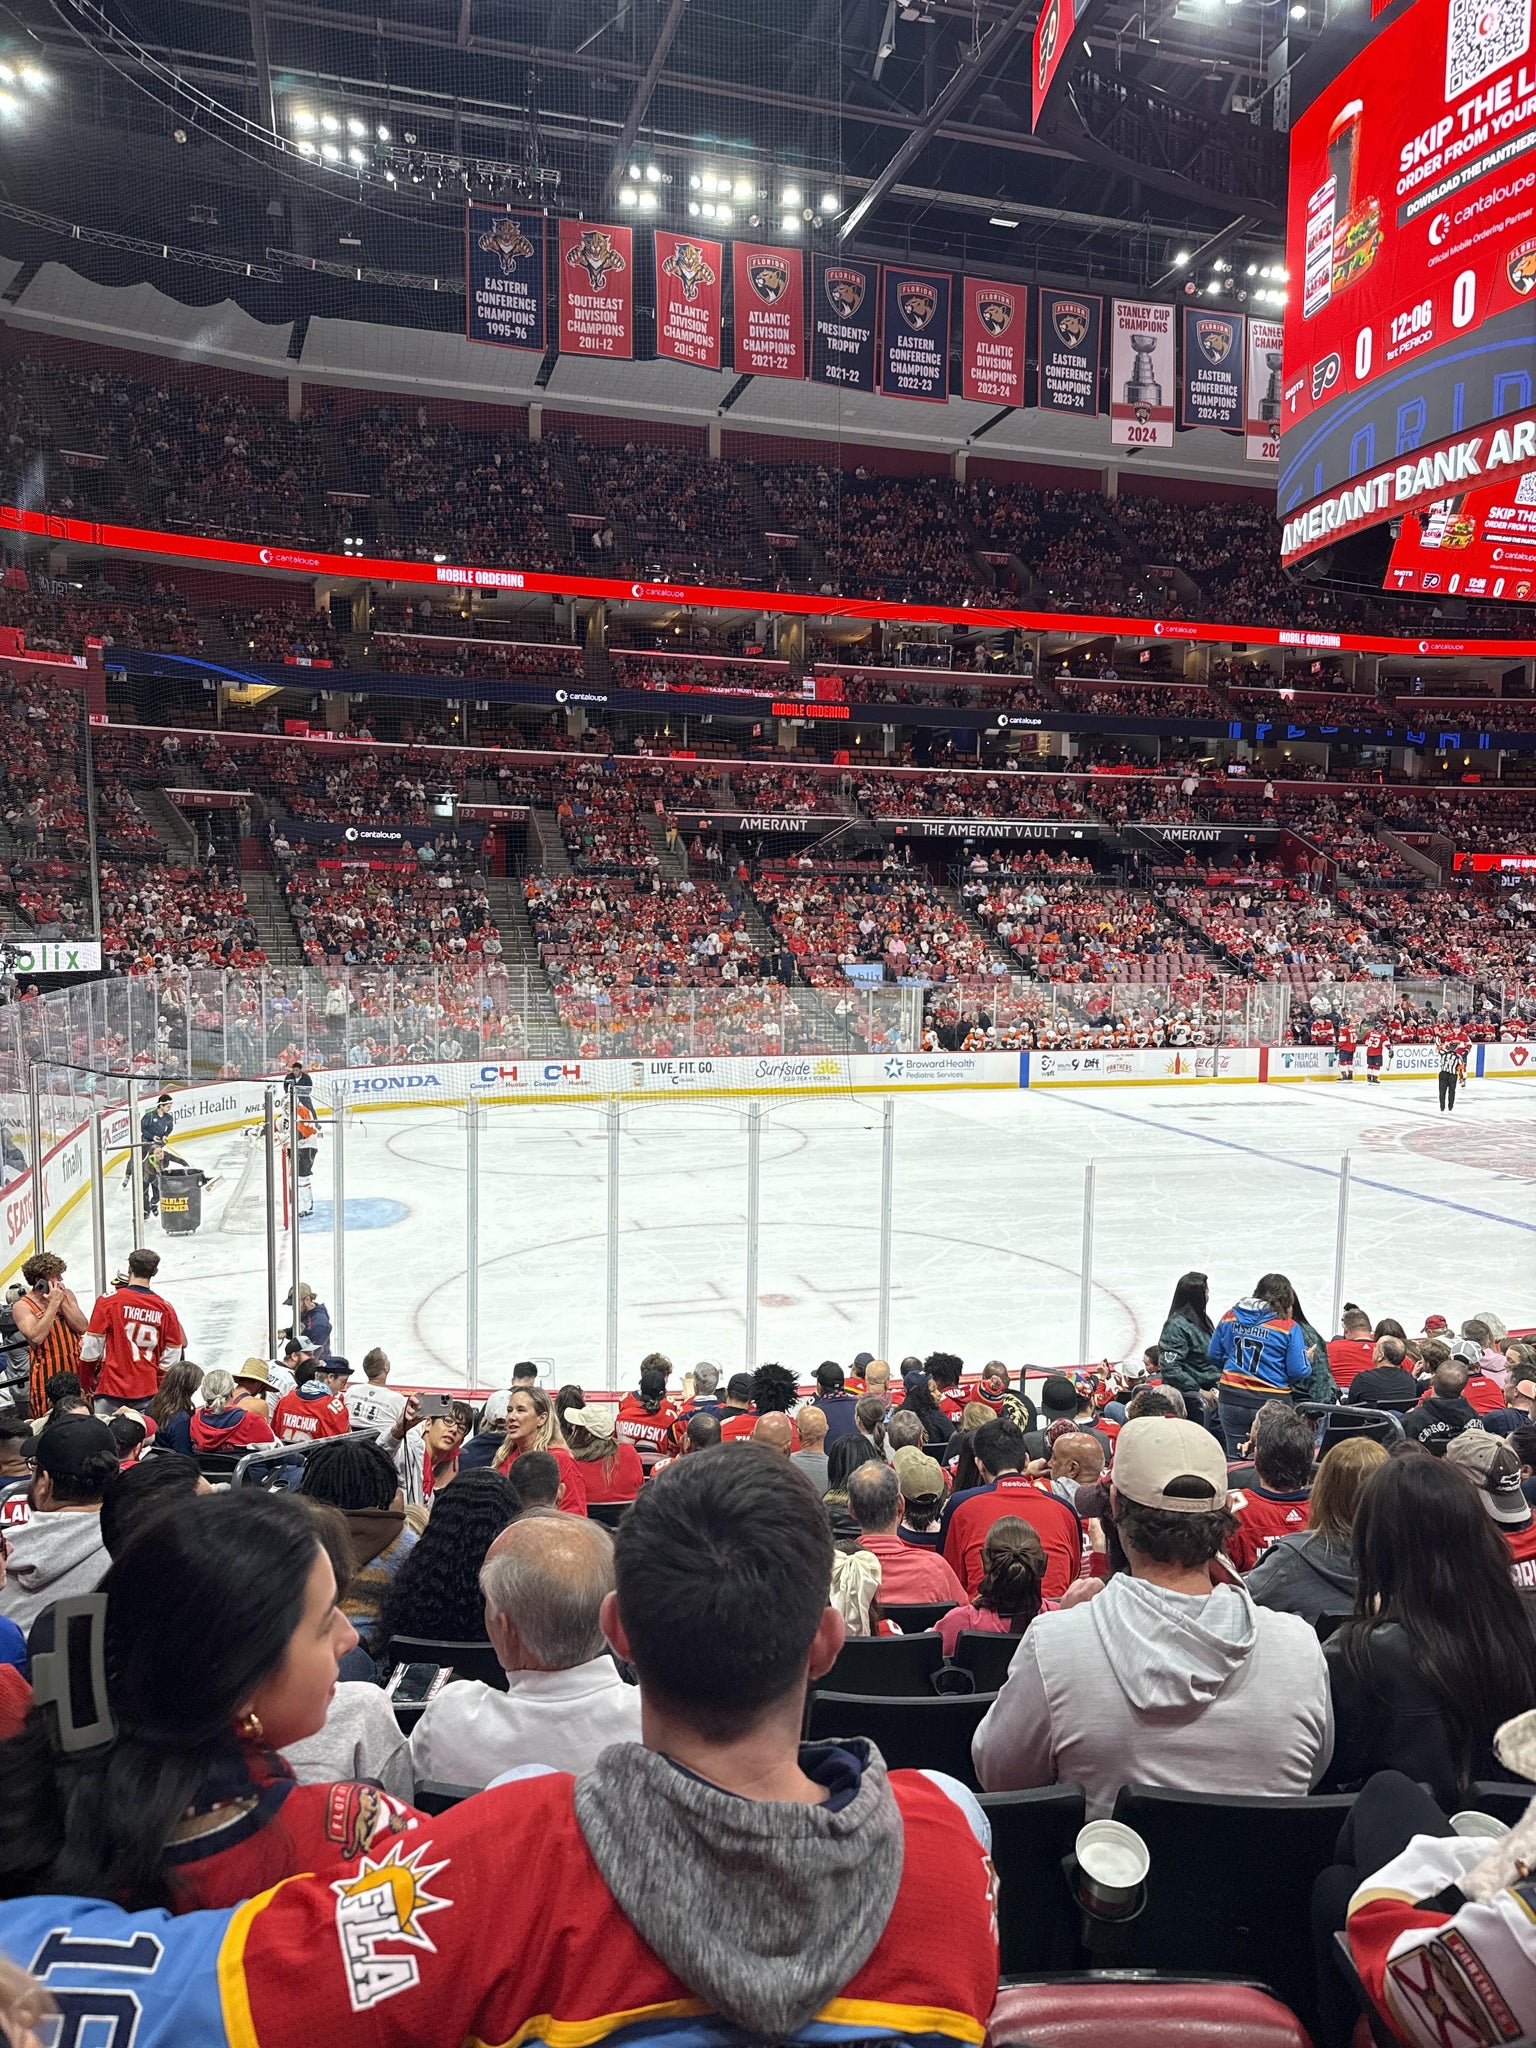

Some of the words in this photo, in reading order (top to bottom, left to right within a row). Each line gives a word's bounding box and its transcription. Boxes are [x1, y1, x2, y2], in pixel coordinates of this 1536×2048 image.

[1399, 115, 1453, 172] SKIP
[1457, 75, 1513, 132] THE
[1396, 153, 1442, 195] ORDER
[1444, 122, 1488, 165] FROM
[1491, 97, 1536, 135] YOUR
[1406, 175, 1460, 217] DOWNLOAD
[1460, 162, 1482, 184] THE
[1454, 172, 1536, 225] cantaloupe
[751, 258, 789, 270] FLORIDA
[829, 270, 863, 283] FLORIDA
[484, 278, 529, 295] EASTERN
[902, 286, 933, 298] FLORIDA
[476, 290, 538, 312] CONFERENCE
[568, 294, 624, 310] SOUTHEAST
[981, 294, 1010, 305] FLORIDA
[1452, 270, 1477, 328] 0
[478, 305, 536, 326] CHAMPIONS
[574, 308, 618, 323] DIVISION
[669, 302, 710, 321] ATLANTIC
[748, 311, 790, 326] ATLANTIC
[1057, 305, 1088, 317] FLORIDA
[1117, 305, 1148, 319] STANLEY
[1149, 308, 1171, 322] CUP
[567, 320, 624, 338] CHAMPIONS
[670, 315, 708, 334] DIVISION
[1119, 318, 1168, 334] CHAMPIONS
[1201, 322, 1230, 333] FLORIDA
[1390, 299, 1432, 344] 12:06
[487, 322, 528, 340] 1995-96
[664, 326, 714, 349] CHAMPIONS
[749, 326, 790, 341] DIVISION
[579, 337, 614, 351] 2011-12
[674, 343, 707, 360] 2015-16
[743, 339, 796, 356] CHAMPIONS
[827, 338, 860, 355] TROPHY
[898, 336, 935, 351] EASTERN
[976, 341, 1014, 358] ATLANTIC
[1255, 337, 1283, 351] CHAMP
[1386, 344, 1399, 362] 1st
[1399, 330, 1432, 356] PERIOD
[890, 348, 942, 366] CONFERENCE
[1052, 353, 1087, 369] EASTERN
[1355, 326, 1373, 380] 0
[752, 354, 789, 370] 2021-22
[977, 355, 1012, 371] DIVISION
[826, 365, 860, 383] 2021-22
[891, 362, 940, 380] CHAMPIONS
[971, 368, 1018, 385] CHAMPIONS
[1045, 364, 1094, 383] CONFERENCE
[1198, 369, 1232, 384] EASTERN
[898, 376, 933, 391] 2022-23
[977, 382, 1010, 398] 2023-24
[1047, 378, 1092, 396] CHAMPIONS
[1191, 381, 1238, 398] CONFERENCE
[1285, 379, 1304, 400] SHOTS
[1053, 392, 1085, 407] 2023-24
[1191, 394, 1237, 410] CHAMPIONS
[1198, 407, 1231, 421] 2024-25
[1128, 426, 1158, 442] 2024
[1281, 472, 1395, 556] AMERANT
[1395, 437, 1485, 501] BANK
[1485, 420, 1536, 472] AR
[1488, 506, 1516, 520] SKIP
[1484, 521, 1510, 530] ORDER
[275, 553, 321, 567] cantaloupe
[436, 568, 473, 586] MOBILE
[475, 570, 525, 589] ORDERING
[1394, 570, 1413, 579] SHOTS
[645, 586, 686, 599] cantaloupe
[1165, 624, 1198, 635] cantaloupe
[1279, 631, 1305, 646] MOBILE
[1306, 633, 1341, 648] ORDERING
[1430, 642, 1465, 652] cantaloupe
[569, 690, 608, 704] cantaloupe
[771, 702, 805, 718] MOBILE
[806, 704, 850, 719] ORDERING
[1009, 716, 1043, 726] cantaloupe
[461, 809, 476, 818] 132
[739, 818, 809, 832] AMERANT
[922, 823, 945, 837] THE
[948, 824, 1011, 838] AMERANT
[1015, 826, 1060, 839] VAULT
[360, 829, 402, 840] cantaloupe
[1162, 828, 1222, 842] AMERANT
[1396, 1048, 1439, 1059] COMCAS
[651, 1062, 676, 1075] LIVE.
[679, 1062, 696, 1074] FIT.
[698, 1061, 715, 1074] GO.
[756, 1060, 810, 1079] Surfside
[906, 1058, 946, 1069] Broward
[946, 1057, 974, 1069] Health
[1396, 1059, 1439, 1069] BUSINES
[480, 1065, 518, 1082] CH
[544, 1064, 580, 1080] CH
[906, 1070, 939, 1079] Pediatric
[940, 1069, 964, 1078] Services
[352, 1074, 442, 1094] HONDA
[198, 1096, 237, 1115] Health
[123, 1305, 162, 1325] TKACHUK
[124, 1322, 159, 1362] 19
[1234, 1336, 1265, 1375] 17
[282, 1413, 319, 1432] TKACHUK
[1002, 1480, 1032, 1489] Reebok
[337, 1880, 420, 2008] FLA
